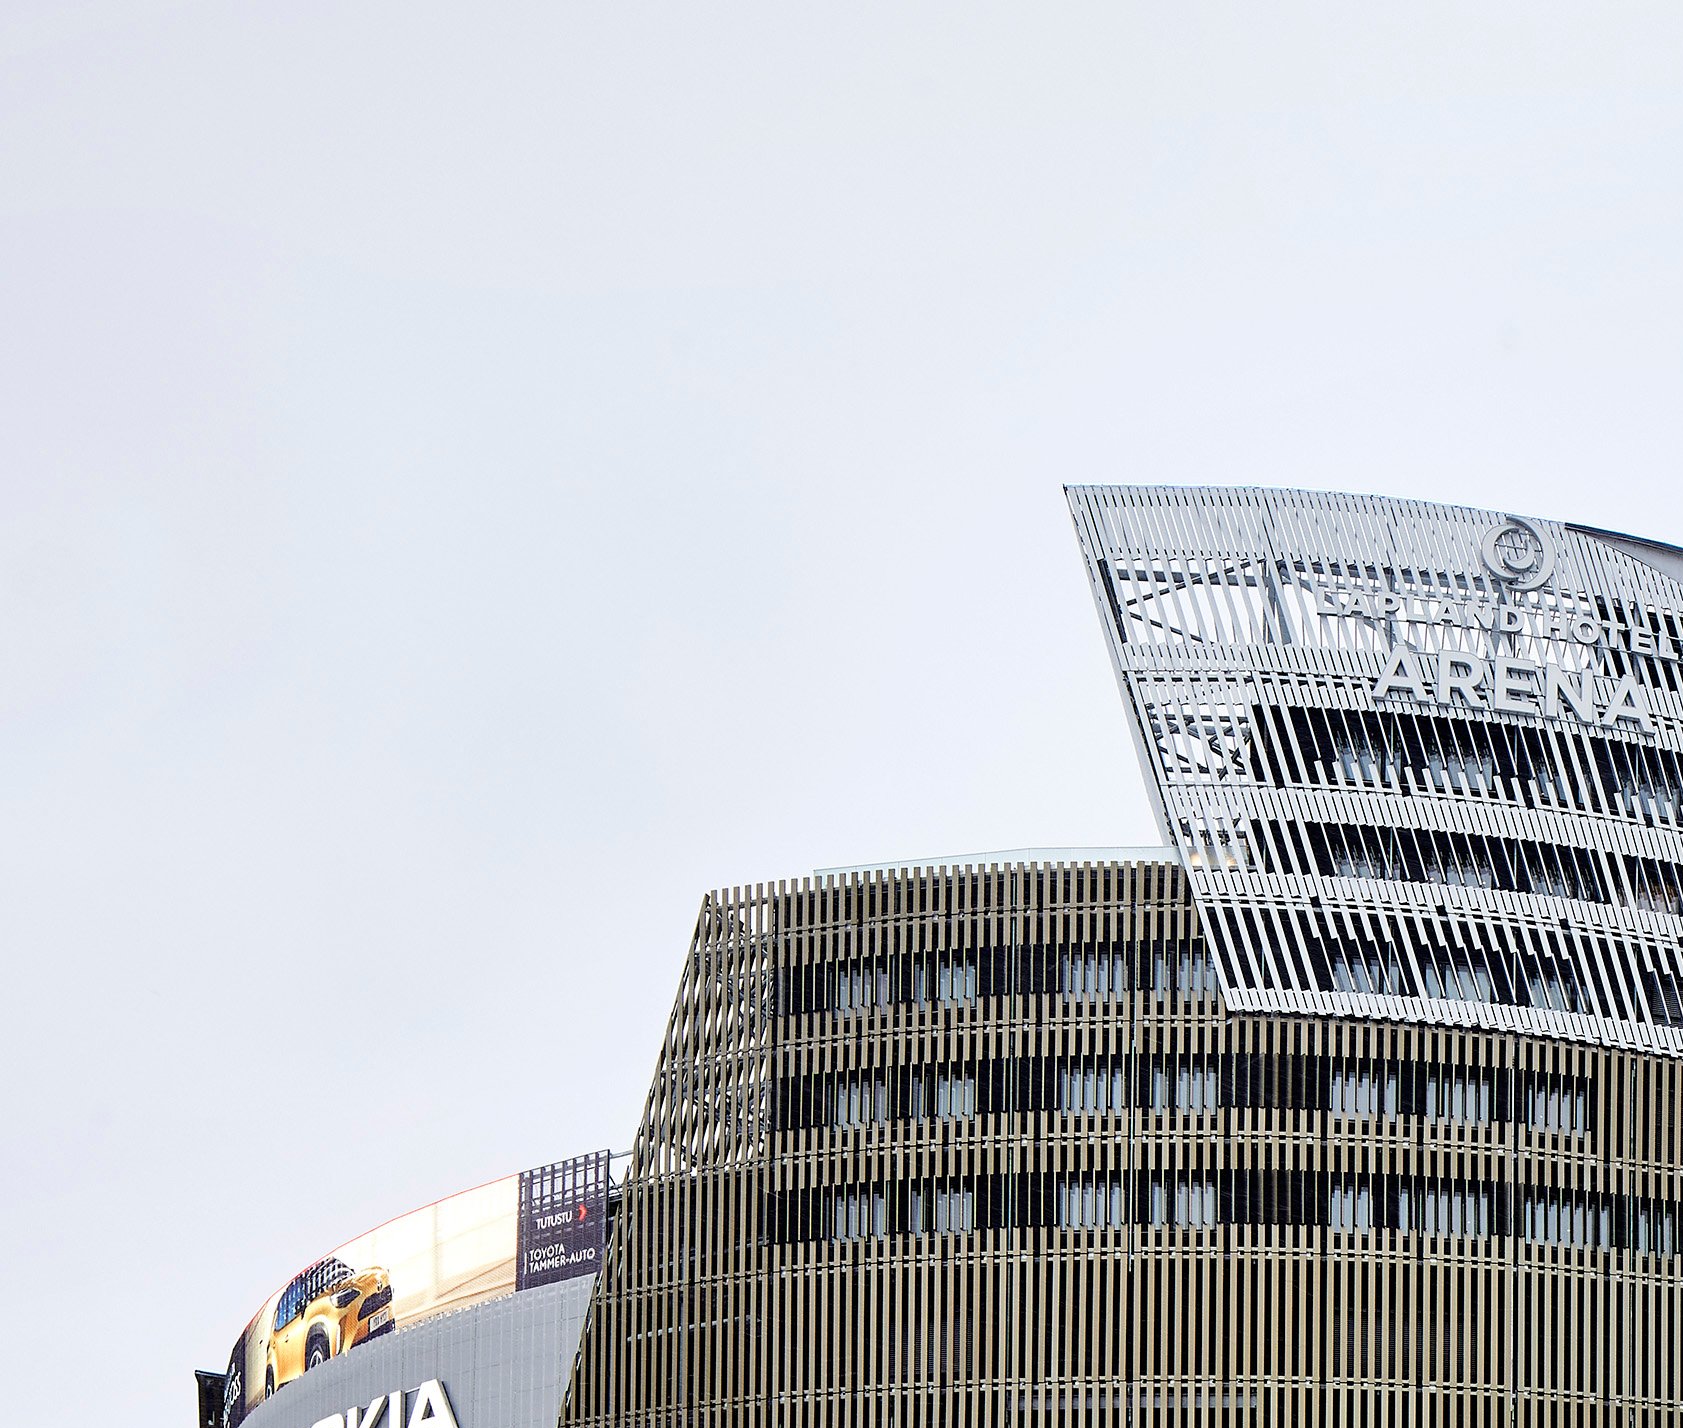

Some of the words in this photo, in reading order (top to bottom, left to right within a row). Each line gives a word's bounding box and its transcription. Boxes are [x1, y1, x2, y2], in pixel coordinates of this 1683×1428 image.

[1316, 587, 1526, 634] LAPLAND
[1371, 644, 1656, 737] ARENA
[535, 1210, 573, 1230] TUTUSTU
[528, 1247, 596, 1275] TAMMER-AUTO
[529, 1243, 565, 1262] TOYOTA
